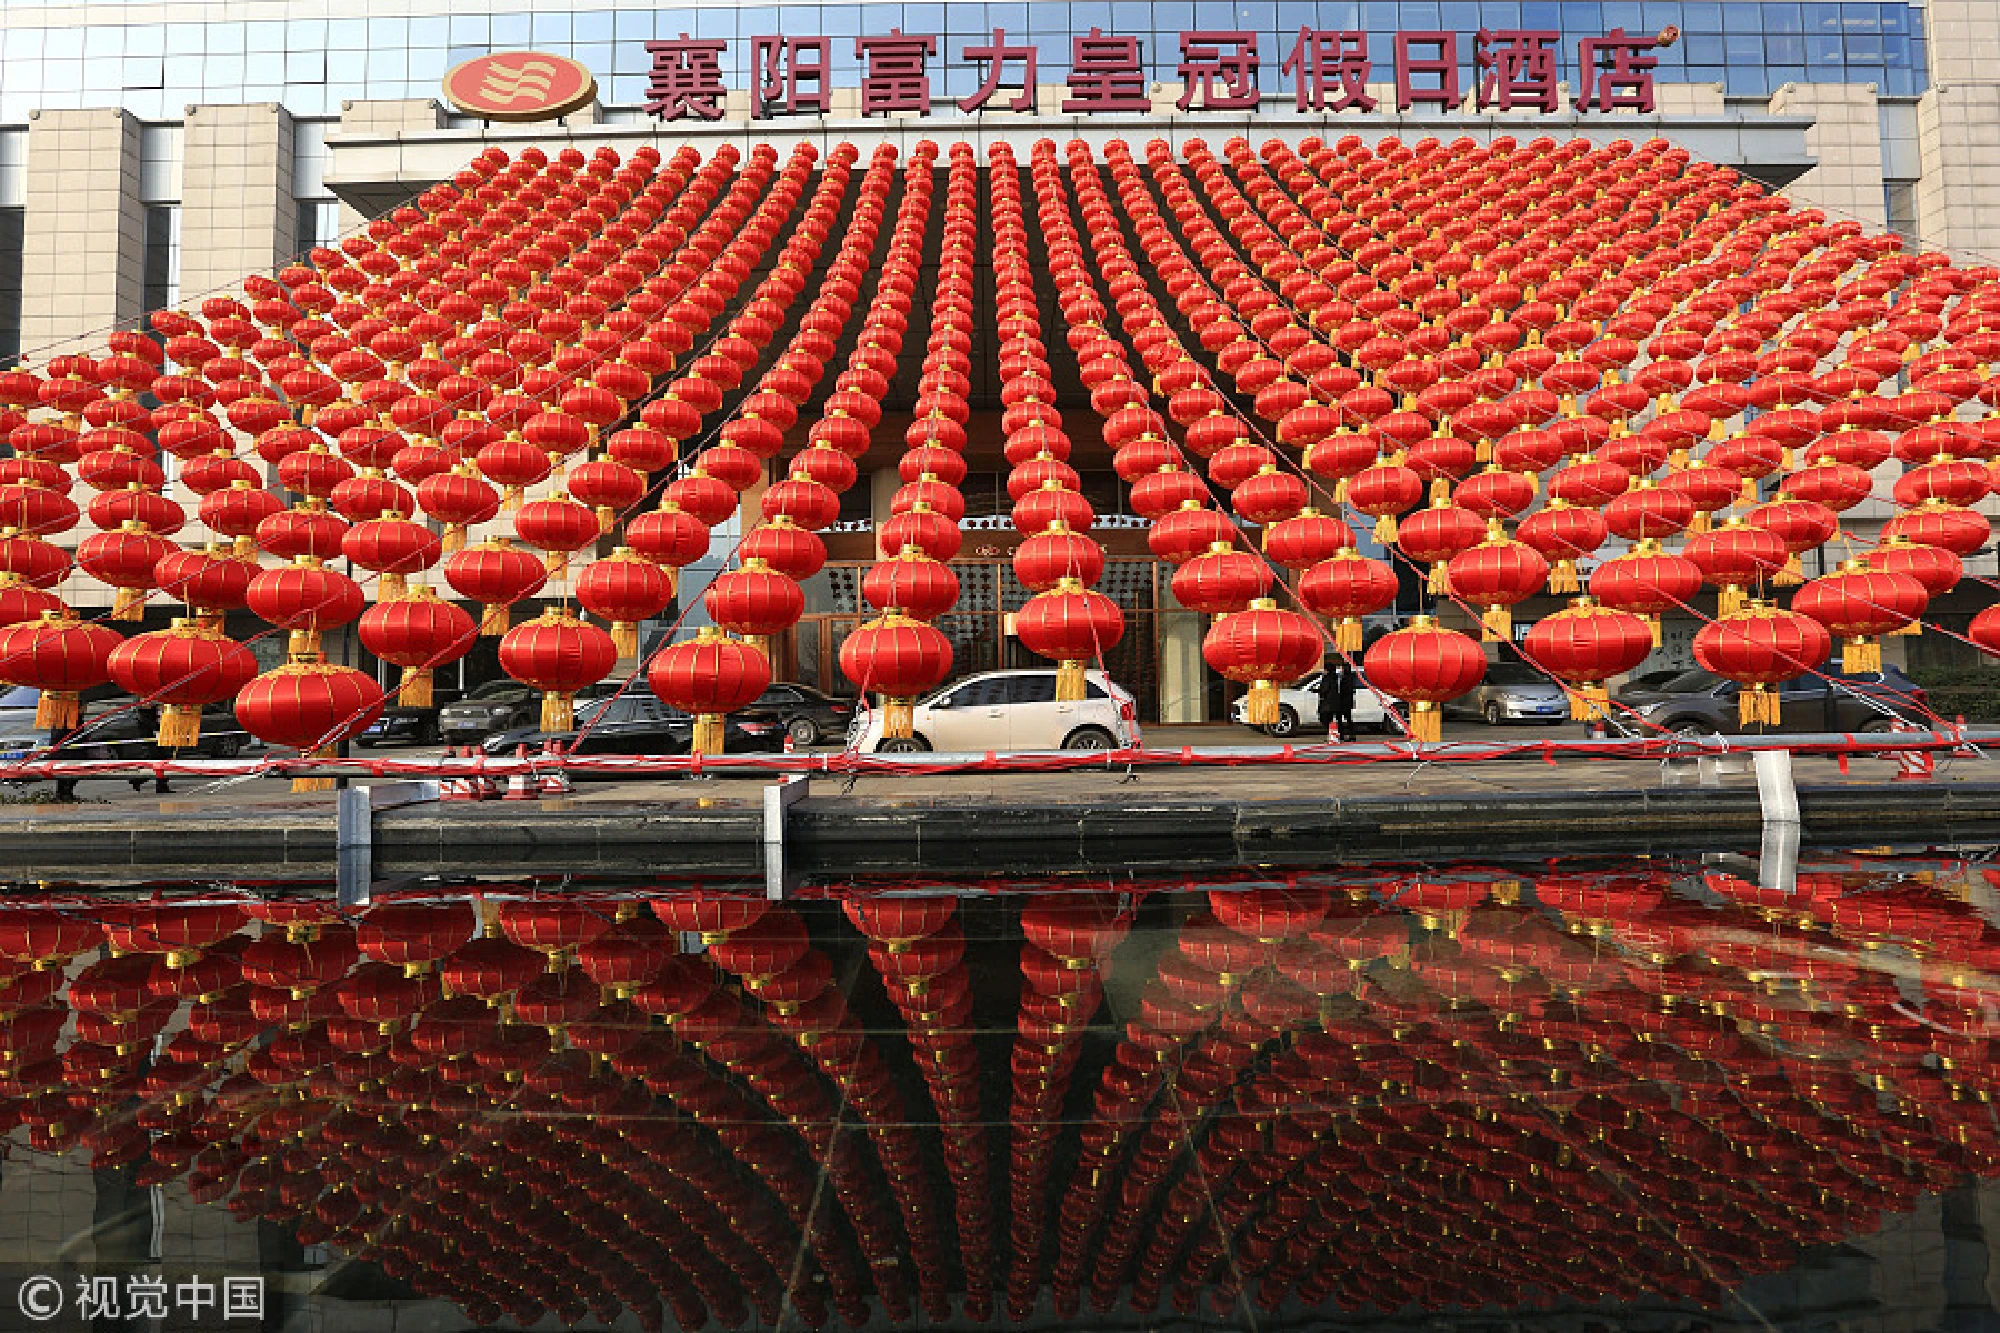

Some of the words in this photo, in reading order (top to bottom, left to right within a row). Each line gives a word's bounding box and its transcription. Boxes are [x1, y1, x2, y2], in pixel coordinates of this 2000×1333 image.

[642, 25, 1658, 121] 襄阳富力皇冠假日酒店
